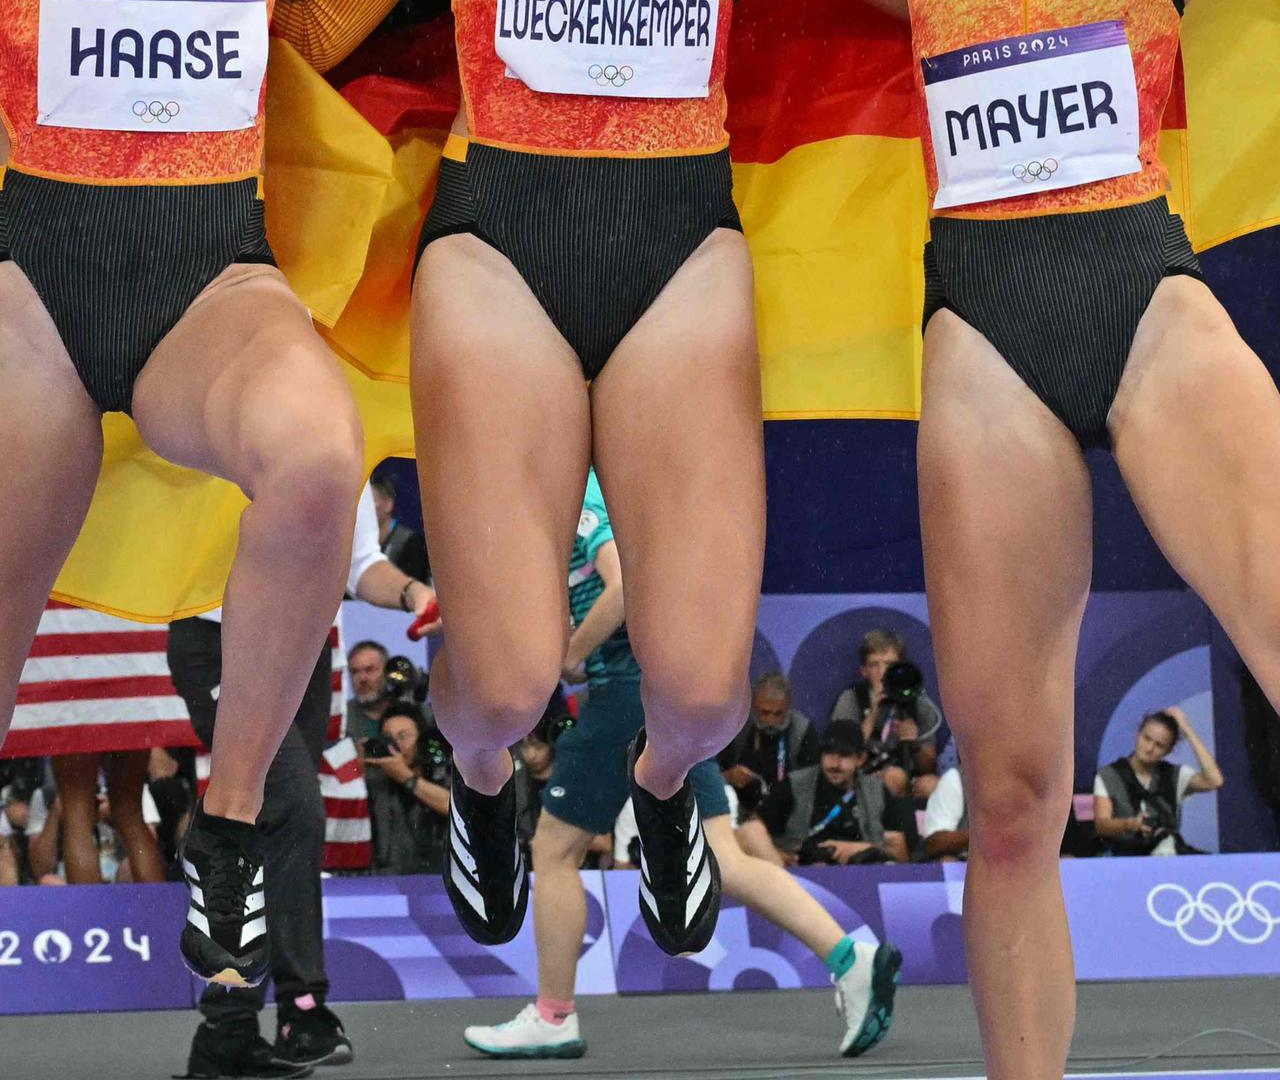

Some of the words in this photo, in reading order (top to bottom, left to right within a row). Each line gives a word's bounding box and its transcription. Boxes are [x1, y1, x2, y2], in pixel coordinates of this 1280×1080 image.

[70, 26, 243, 79] HAASE
[1019, 35, 1069, 55] 2024
[945, 80, 1119, 156] MAYER
